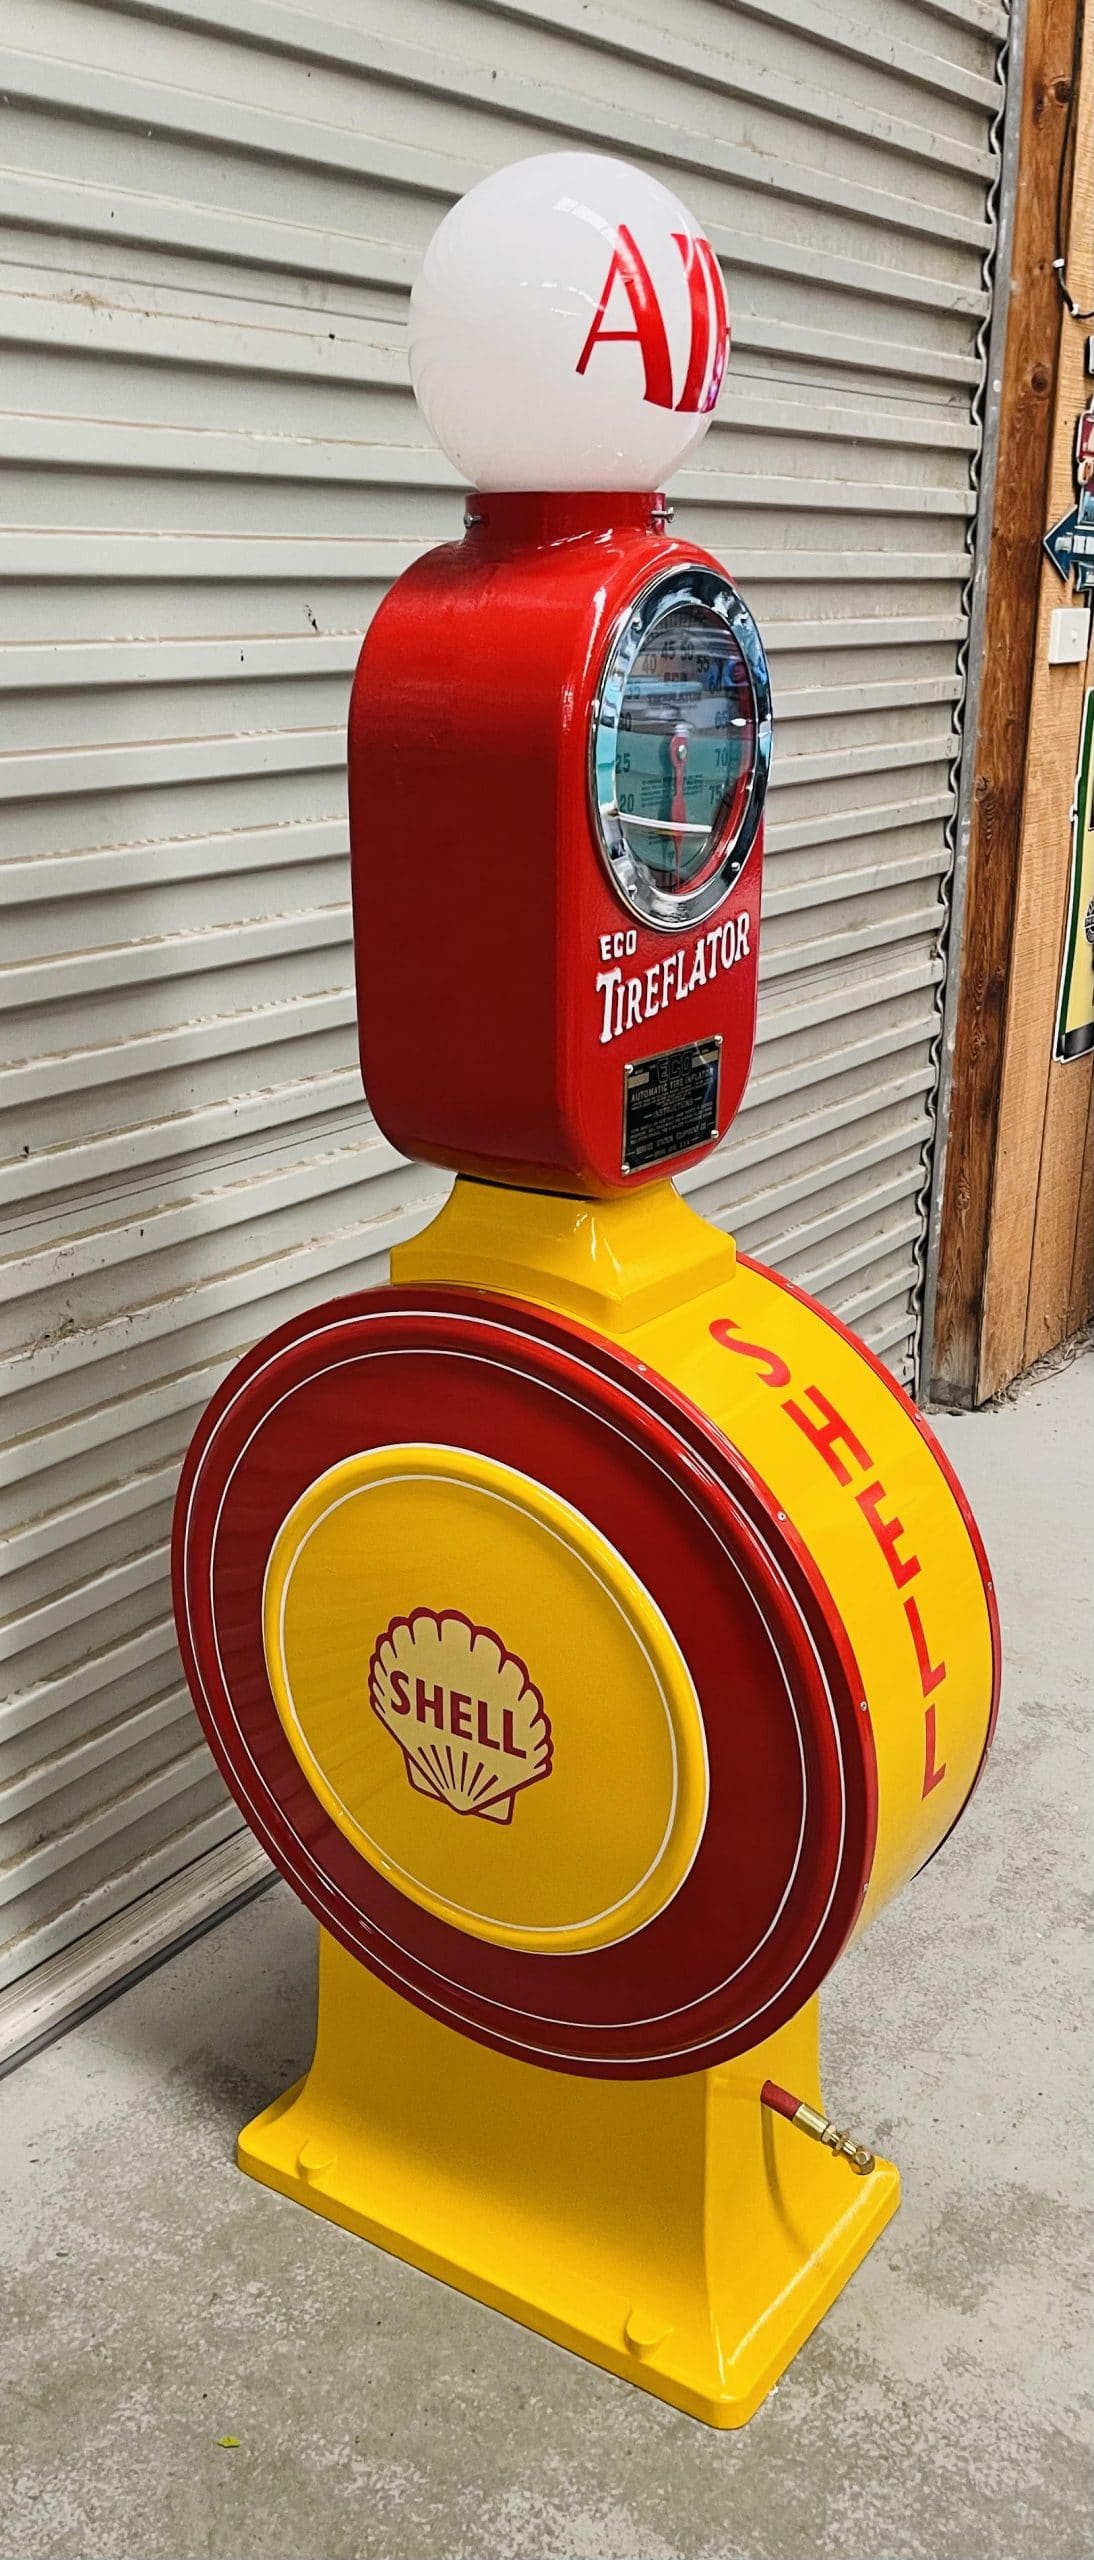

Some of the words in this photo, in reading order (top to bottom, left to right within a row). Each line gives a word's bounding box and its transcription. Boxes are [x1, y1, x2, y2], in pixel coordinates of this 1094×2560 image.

[642, 654, 657, 673] 40
[697, 656, 710, 673] 55
[615, 753, 631, 774] 25
[715, 749, 727, 766] 70
[619, 794, 634, 813] 20
[709, 785, 723, 804] 75
[599, 929, 638, 961] ECO
[595, 911, 751, 1044] TIREFLATOR
[657, 1051, 693, 1084] ECO
[631, 1083, 668, 1102] AUTOMATIC
[708, 1318, 947, 1801] SHELL
[389, 1669, 527, 1760] SHELL
